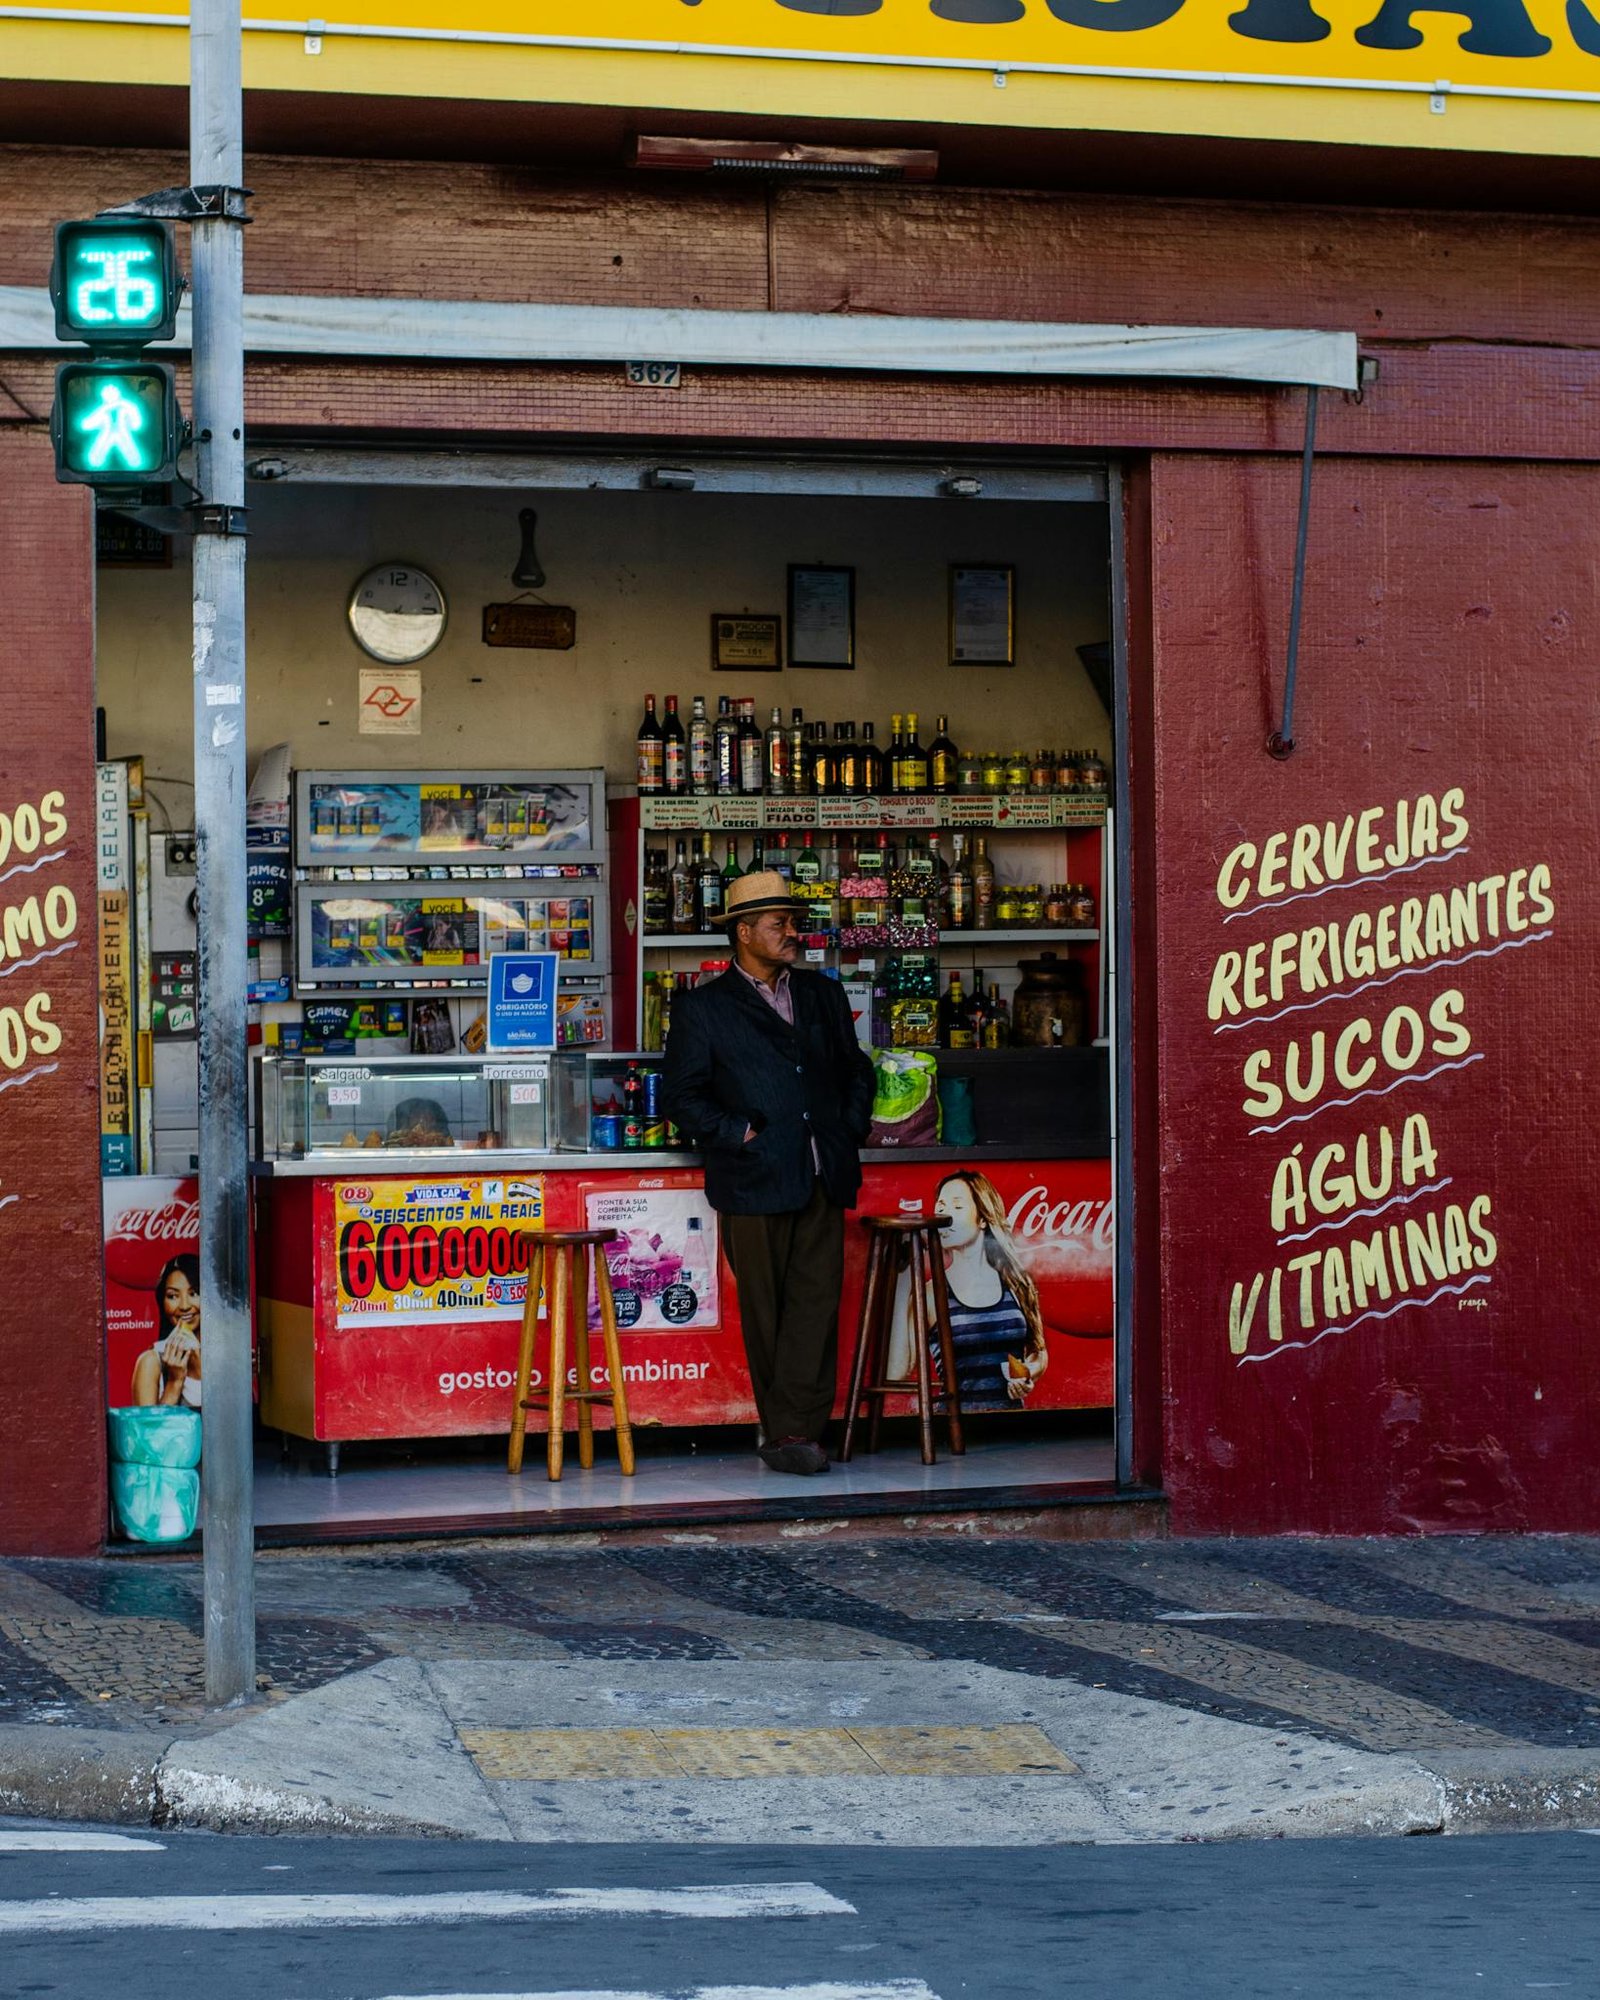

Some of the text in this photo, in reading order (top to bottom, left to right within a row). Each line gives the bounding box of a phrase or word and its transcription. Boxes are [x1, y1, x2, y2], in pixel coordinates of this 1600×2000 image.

[79, 251, 155, 320] 26
[629, 364, 679, 383] 367
[390, 572, 408, 586] 12
[720, 735, 730, 776] VODKA
[916, 797, 935, 805] BOLSO
[101, 770, 118, 880] GELADA
[1216, 787, 1470, 908] CERVEJAS
[248, 864, 287, 880] AMEL
[0, 886, 77, 963] MO
[1206, 864, 1554, 1020] REFRIGERANTES
[104, 899, 123, 1124] REDONDAMENTE
[307, 1007, 349, 1019] CAMEL
[496, 1002, 548, 1011] OBRIGATÓRIO
[172, 1012, 191, 1028] LA
[1242, 989, 1471, 1118] SUCOS
[319, 1069, 372, 1083] Salgado
[486, 1067, 544, 1079] Torresmo
[330, 1089, 358, 1102] 3,50
[1270, 1113, 1438, 1232] ÁGUA
[638, 1179, 664, 1188] Coca-Cola
[344, 1187, 368, 1200] 08
[415, 1188, 460, 1199] VIDA CAP
[113, 1200, 200, 1240] ca-Cola
[374, 1203, 542, 1224] SEISCENTOS MIL REAIS
[1228, 1194, 1498, 1354] VITAMINAS
[486, 1285, 502, 1300] 50
[352, 1290, 484, 1312] 20mil 30mil 40mil
[669, 1300, 691, 1316] 5.50
[106, 1308, 132, 1318] stoso
[108, 1320, 154, 1330] combinar
